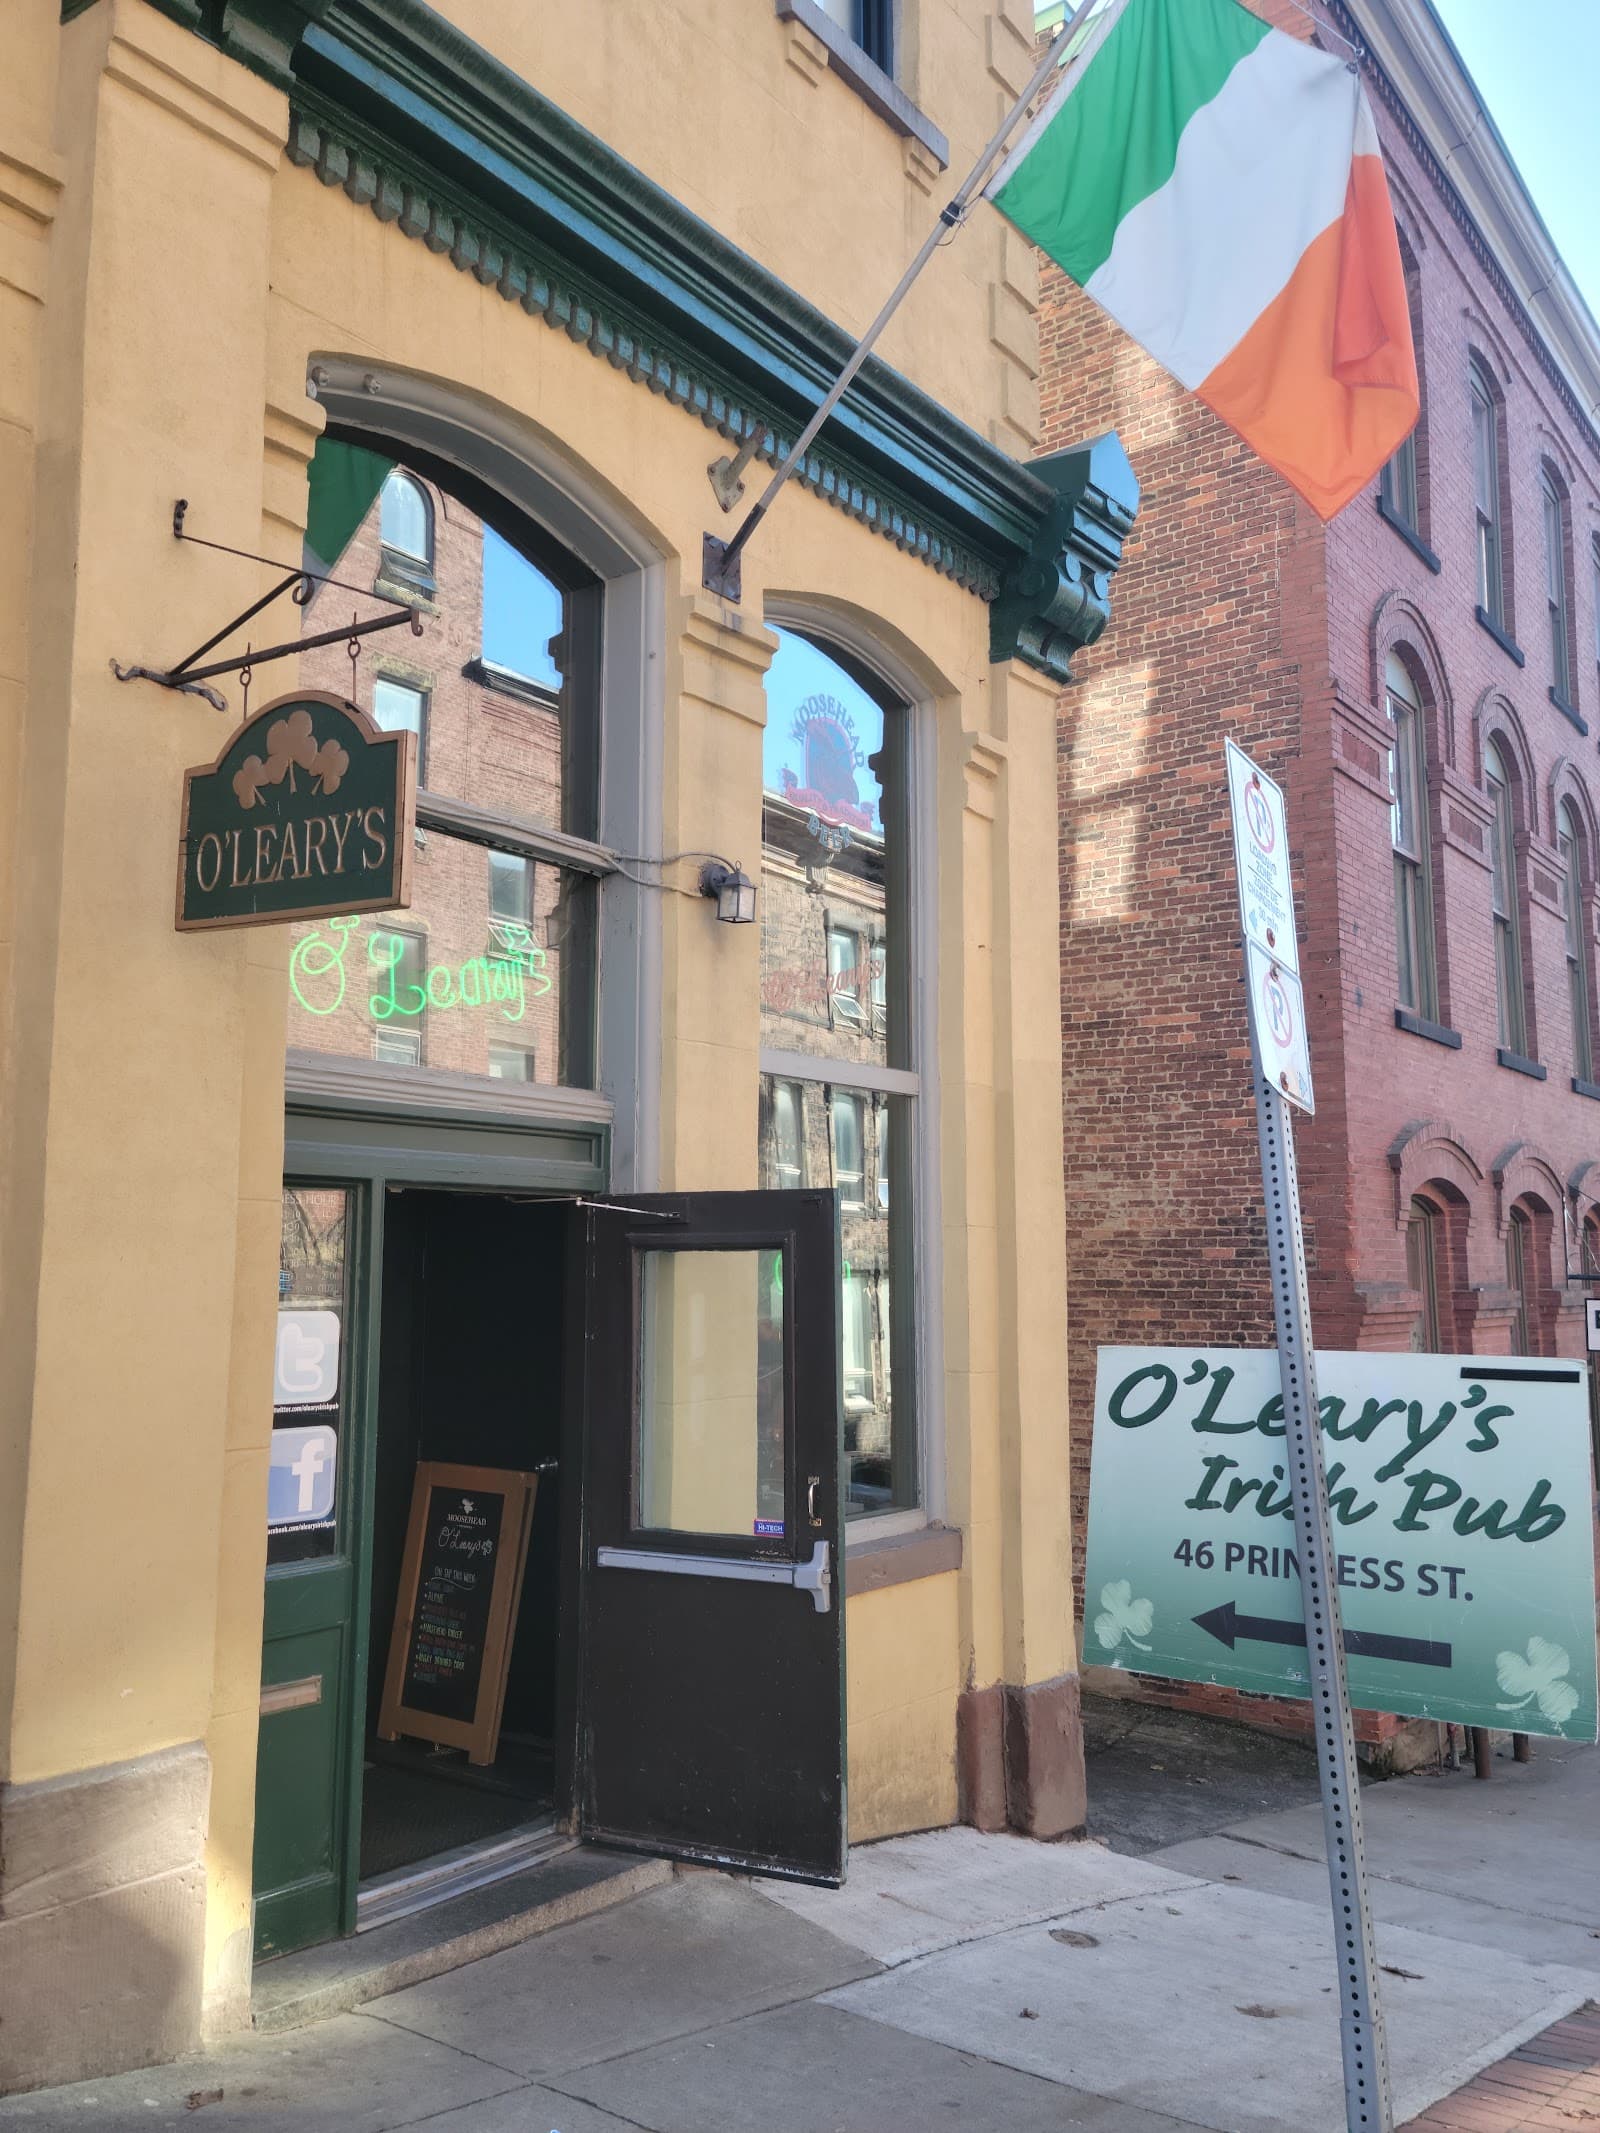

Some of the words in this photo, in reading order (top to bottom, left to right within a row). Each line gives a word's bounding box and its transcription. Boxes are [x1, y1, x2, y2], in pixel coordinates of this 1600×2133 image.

[791, 694, 865, 768] MOOSEHEAD
[196, 806, 386, 892] O'LEARY'S
[807, 813, 854, 850] BEER
[289, 914, 552, 1022] O'Leary's
[1107, 1359, 1515, 1482] O'Leary's
[447, 1513, 487, 1527] MOOSEHEAD
[758, 1523, 783, 1533] HI-TECH
[1184, 1454, 1379, 1526] Irih
[1392, 1469, 1566, 1543] Pub
[1173, 1538, 1215, 1570] 46
[1224, 1542, 1405, 1593] PRINESS
[1416, 1563, 1474, 1602] ST.
